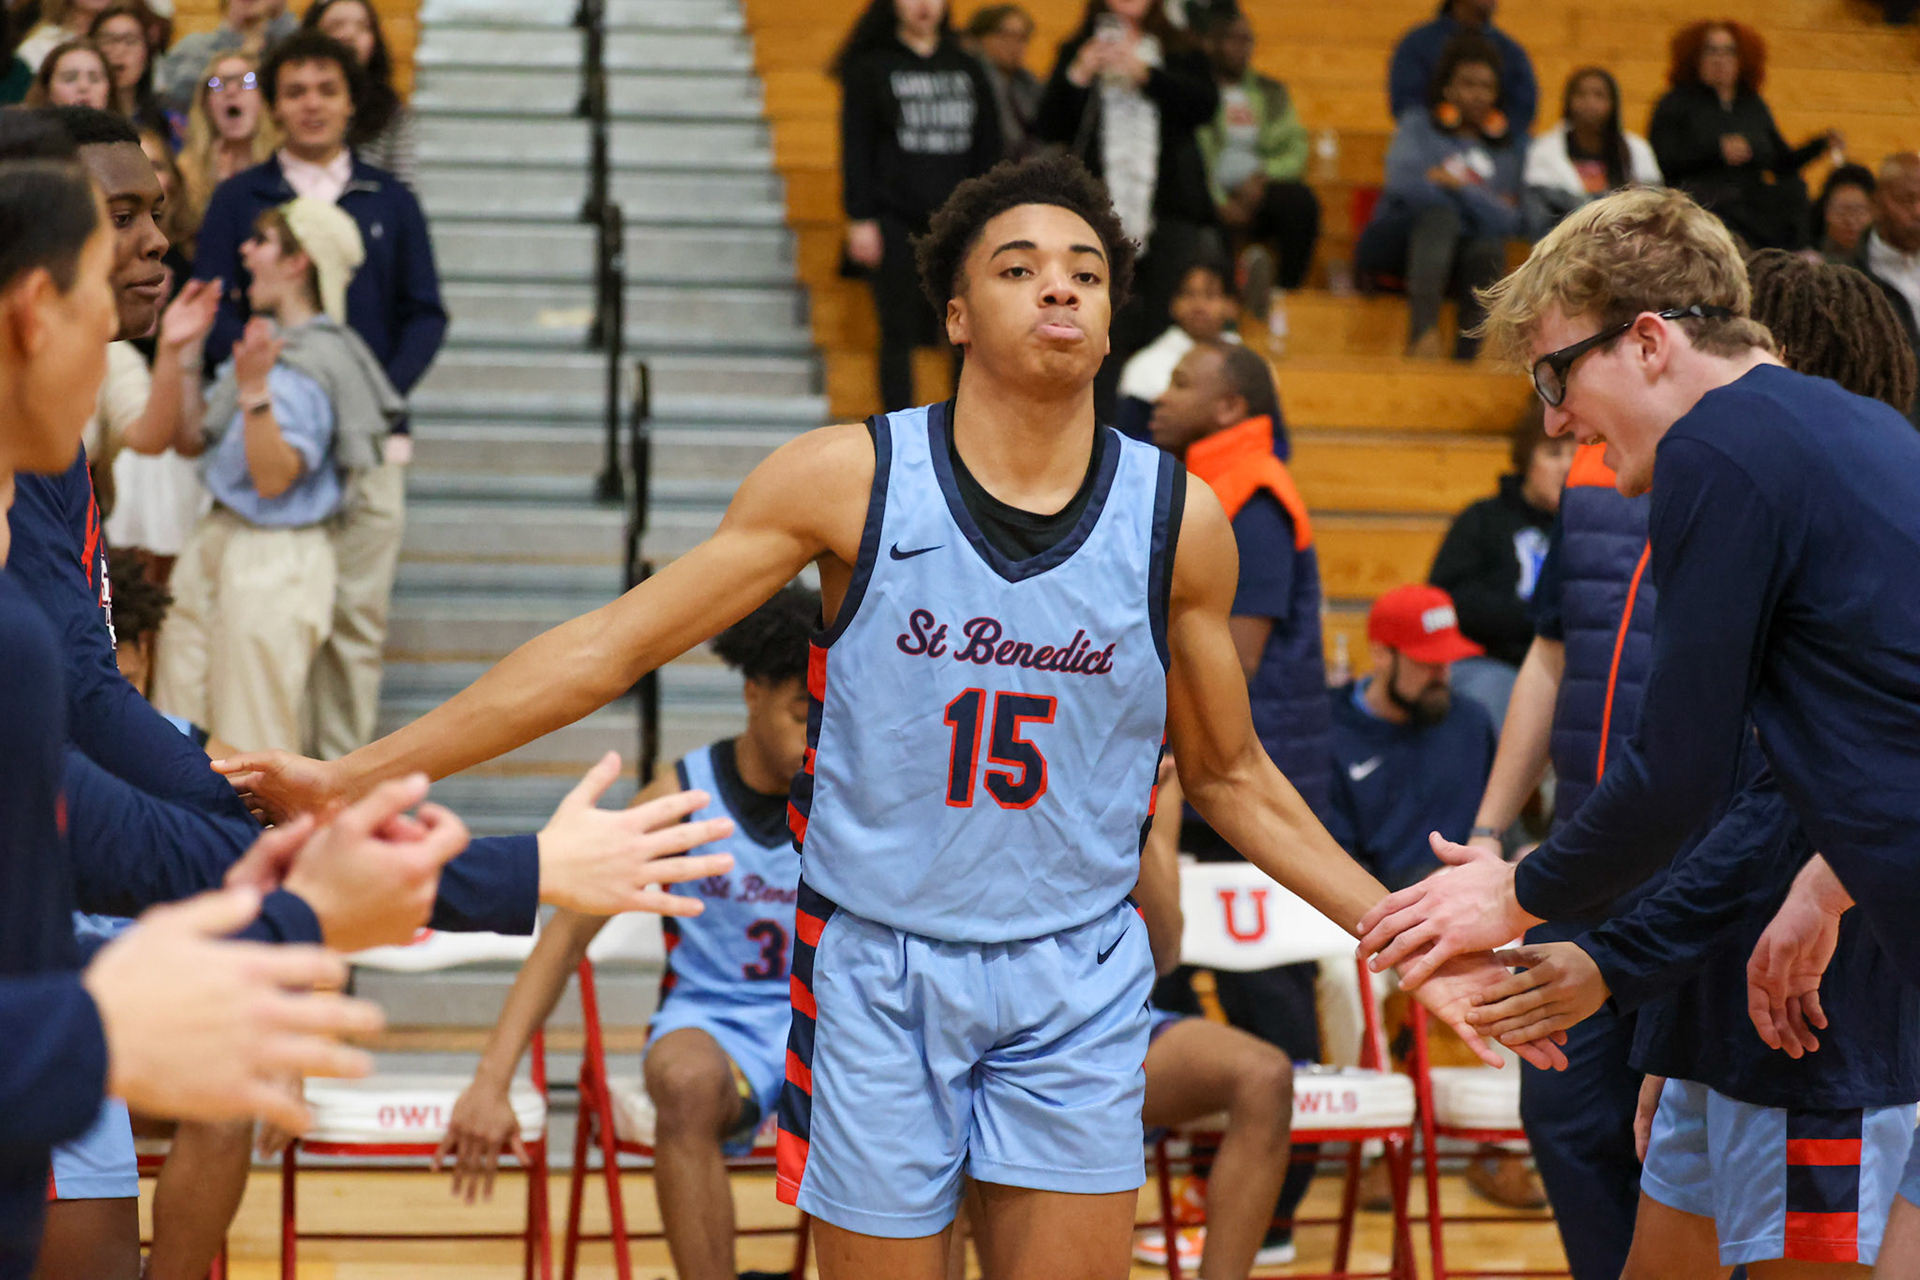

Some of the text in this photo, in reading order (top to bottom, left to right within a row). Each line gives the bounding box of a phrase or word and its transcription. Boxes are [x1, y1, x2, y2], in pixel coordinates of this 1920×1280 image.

[896, 608, 1117, 676] St Benedict
[943, 687, 1058, 810] 15
[1217, 888, 1269, 945] U
[742, 917, 789, 982] 3
[377, 1104, 447, 1129] OWL
[1293, 1090, 1358, 1115] WLS
